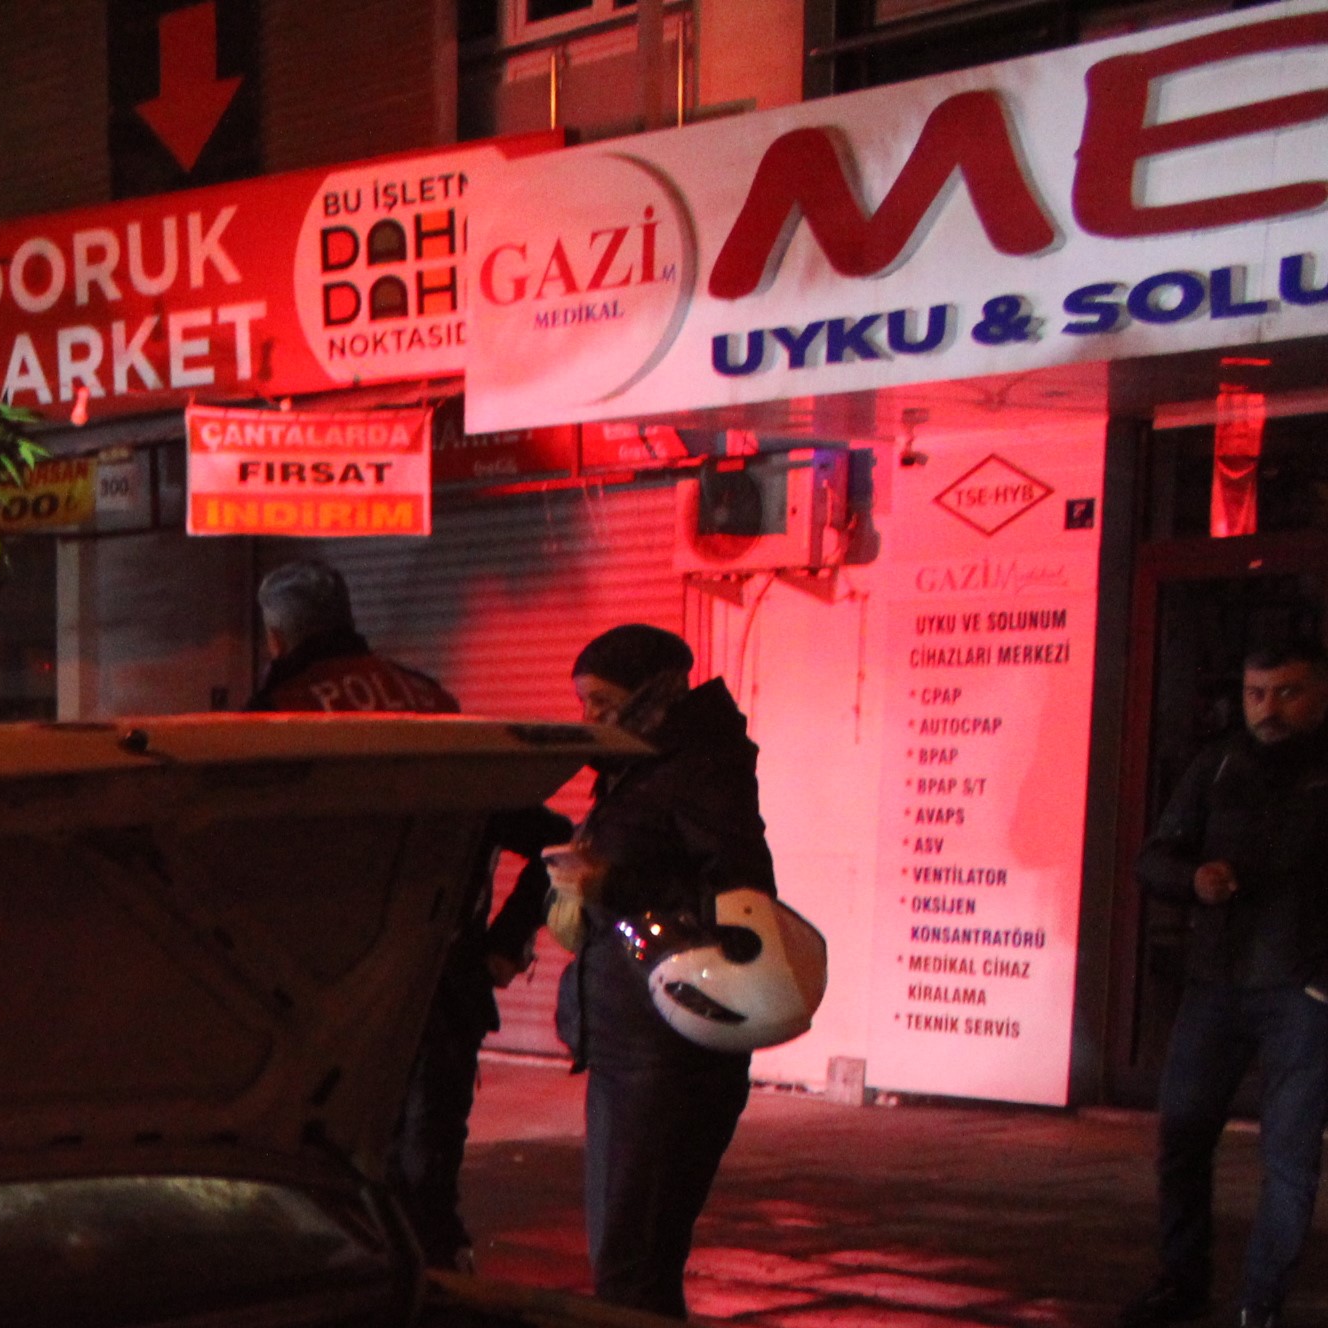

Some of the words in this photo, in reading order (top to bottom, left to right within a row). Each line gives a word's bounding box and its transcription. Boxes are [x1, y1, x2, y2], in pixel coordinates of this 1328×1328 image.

[323, 188, 362, 217] BU
[320, 208, 469, 274] DAH
[480, 205, 666, 306] GAZİ
[322, 264, 468, 329] DAH
[534, 300, 624, 331] MEDİKAL
[712, 304, 951, 377] UYKU
[971, 295, 1033, 346] &
[200, 422, 411, 452] ÇANTALARDA
[238, 460, 393, 485] FIRSAT
[956, 484, 1036, 507] TSE-HYB
[916, 614, 956, 636] UYKU
[962, 613, 982, 633] VE
[987, 608, 1068, 632] SOLUNUM
[909, 644, 992, 669] CİHAZLARI
[997, 638, 1071, 665] MERKEZİ
[921, 688, 962, 706] CPAP
[919, 717, 1003, 737] AUTOCPAP
[918, 747, 959, 766] BPAP
[916, 777, 958, 795] BPAP
[915, 807, 966, 826] AVAPS
[913, 836, 944, 855] ASV
[911, 895, 976, 915] OKSİJEN
[908, 952, 977, 976] MEDİKAL
[982, 956, 1032, 980] CİHAZ
[907, 982, 987, 1007] KİRALAMA
[906, 1010, 960, 1034] TEKNİK
[963, 1013, 1021, 1039] SERVİS
